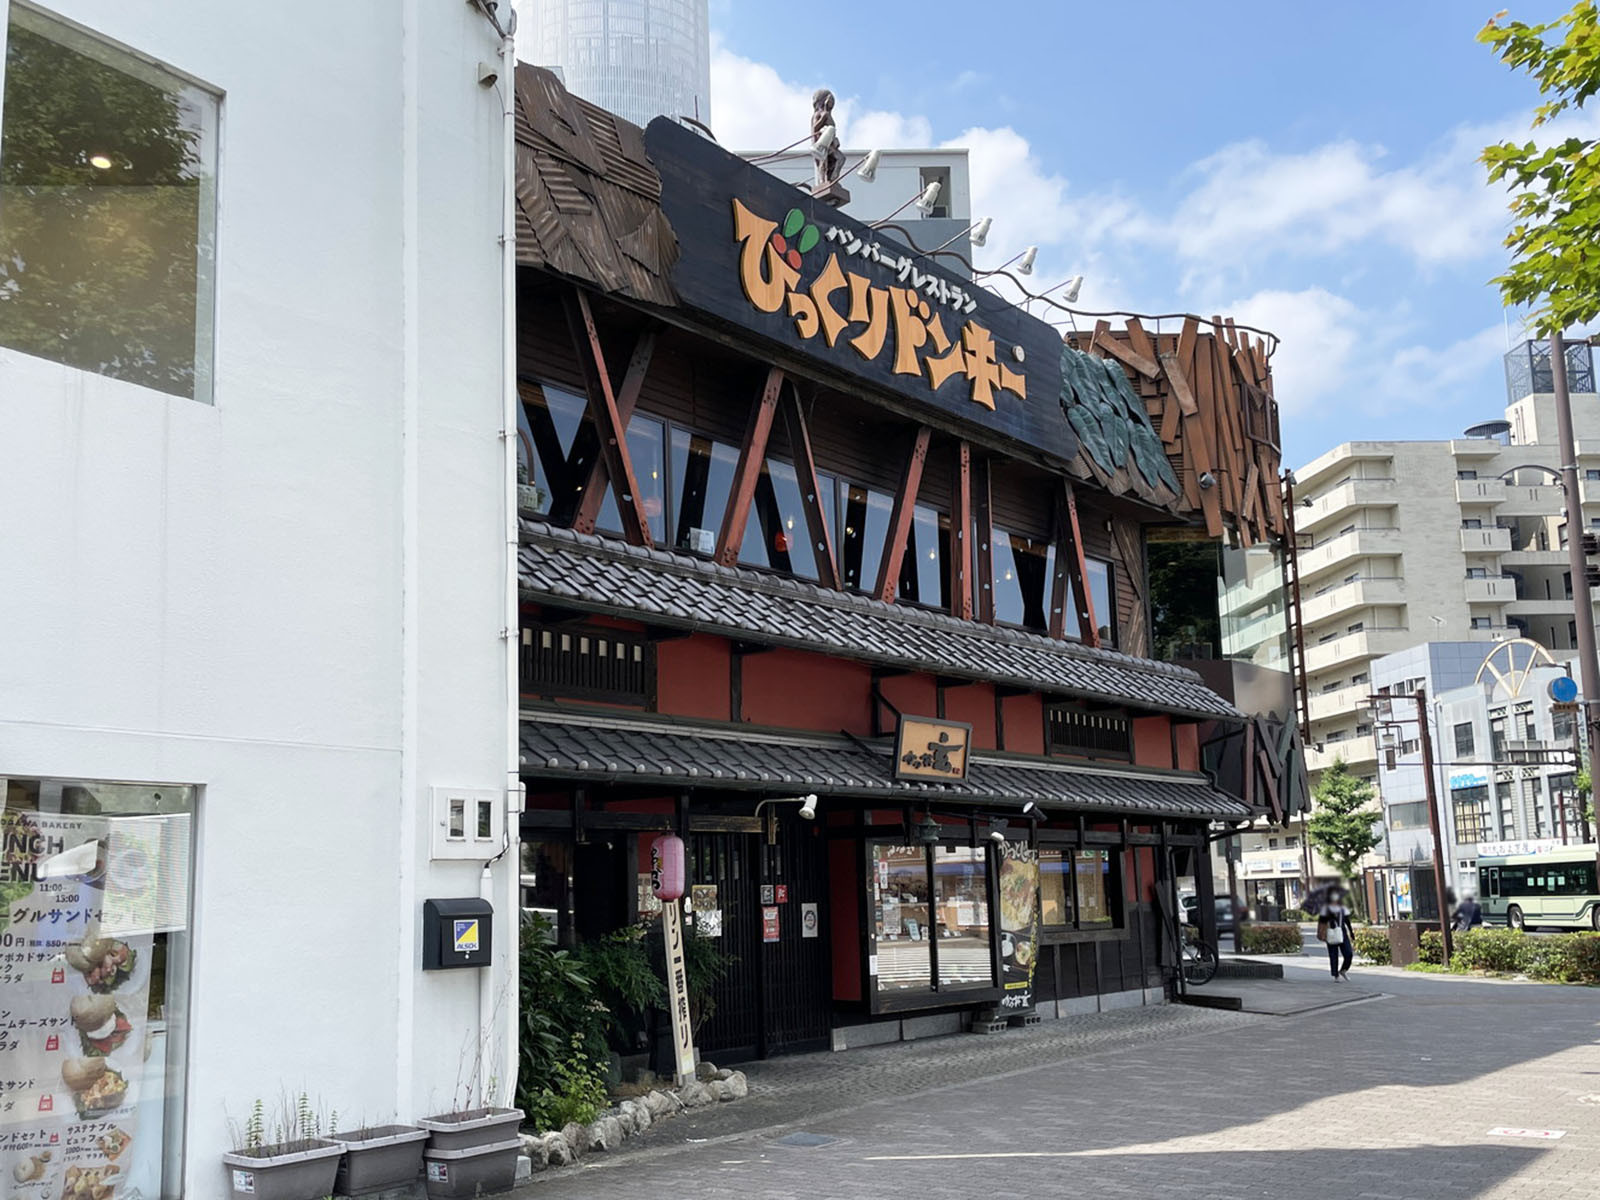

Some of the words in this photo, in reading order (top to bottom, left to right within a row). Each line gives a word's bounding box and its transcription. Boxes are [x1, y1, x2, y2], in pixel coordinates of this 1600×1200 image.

[825, 225, 978, 314] ハンバーグレストラン
[732, 197, 1027, 411] びっくりドンキー
[42, 821, 82, 830] BAKERY
[0, 933, 25, 948] 0円
[0, 973, 24, 984] ラダ
